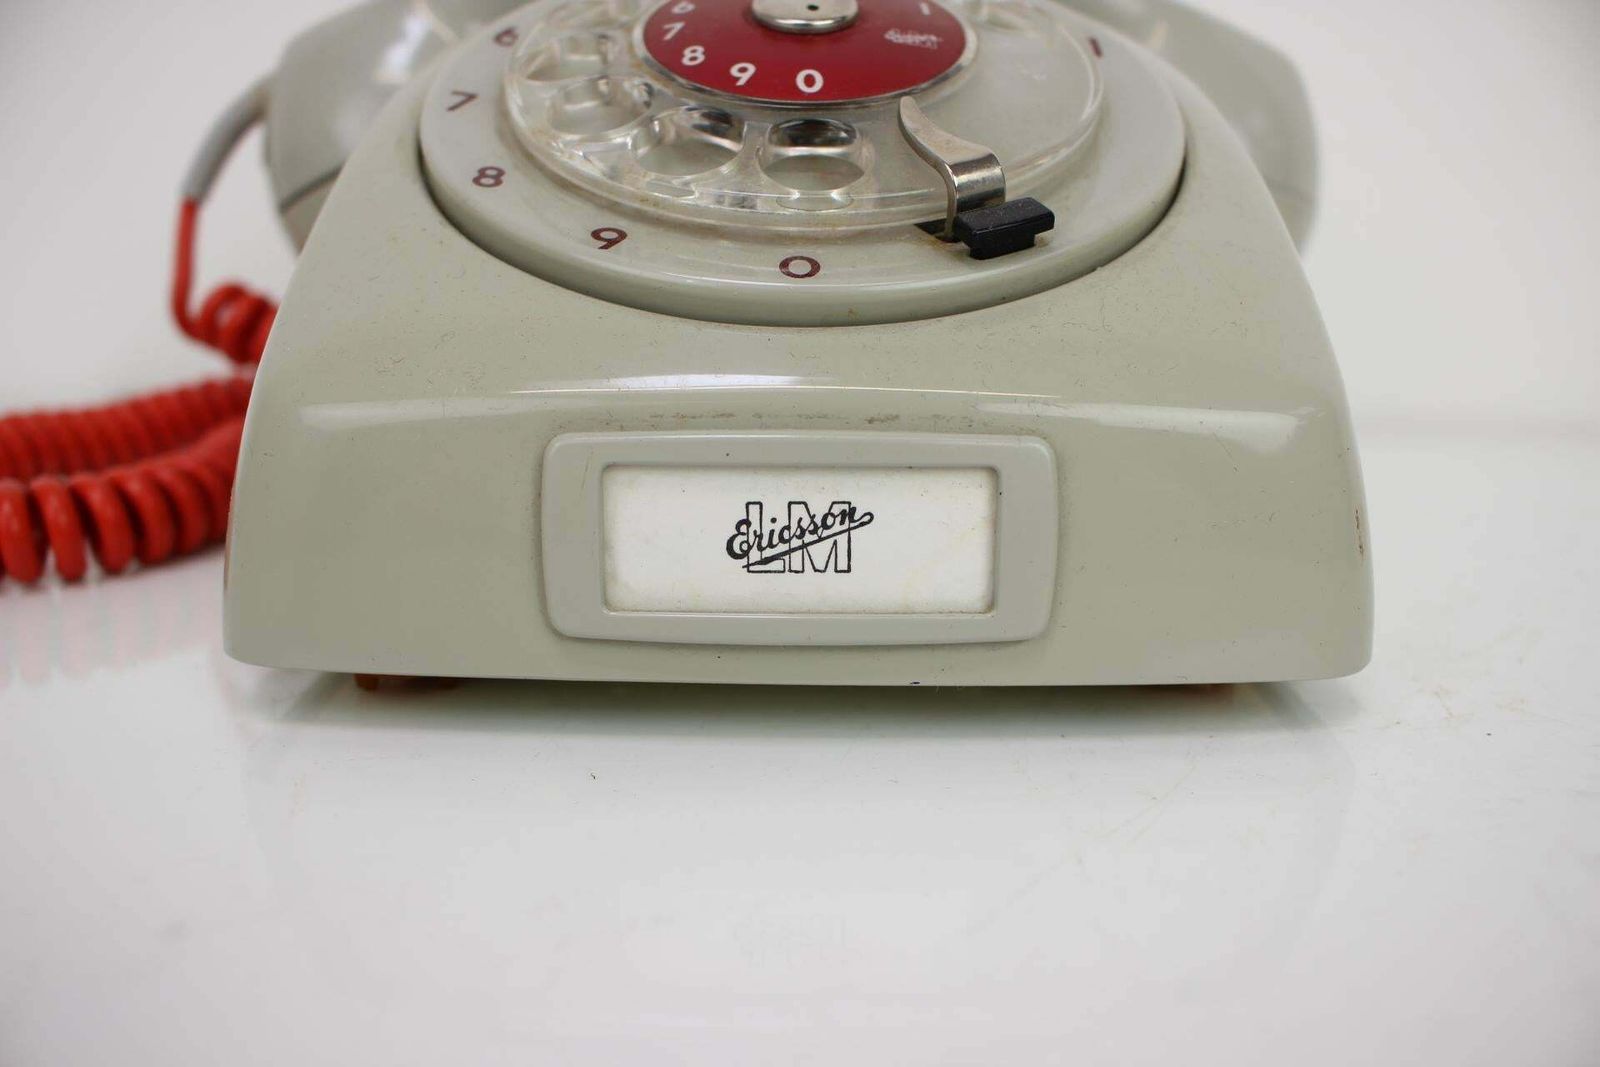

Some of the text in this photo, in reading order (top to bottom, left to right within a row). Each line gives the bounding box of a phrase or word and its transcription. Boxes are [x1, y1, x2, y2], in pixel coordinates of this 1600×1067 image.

[493, 27, 518, 47] 6
[662, 21, 686, 41] 7
[681, 45, 706, 66] 8
[729, 62, 757, 86] 9
[795, 69, 824, 94] 0
[446, 90, 478, 112] 7
[472, 166, 506, 188] 8
[590, 227, 628, 250] 9
[779, 255, 821, 279] 0
[726, 506, 875, 568] Ericsson
[745, 501, 852, 573] LM
